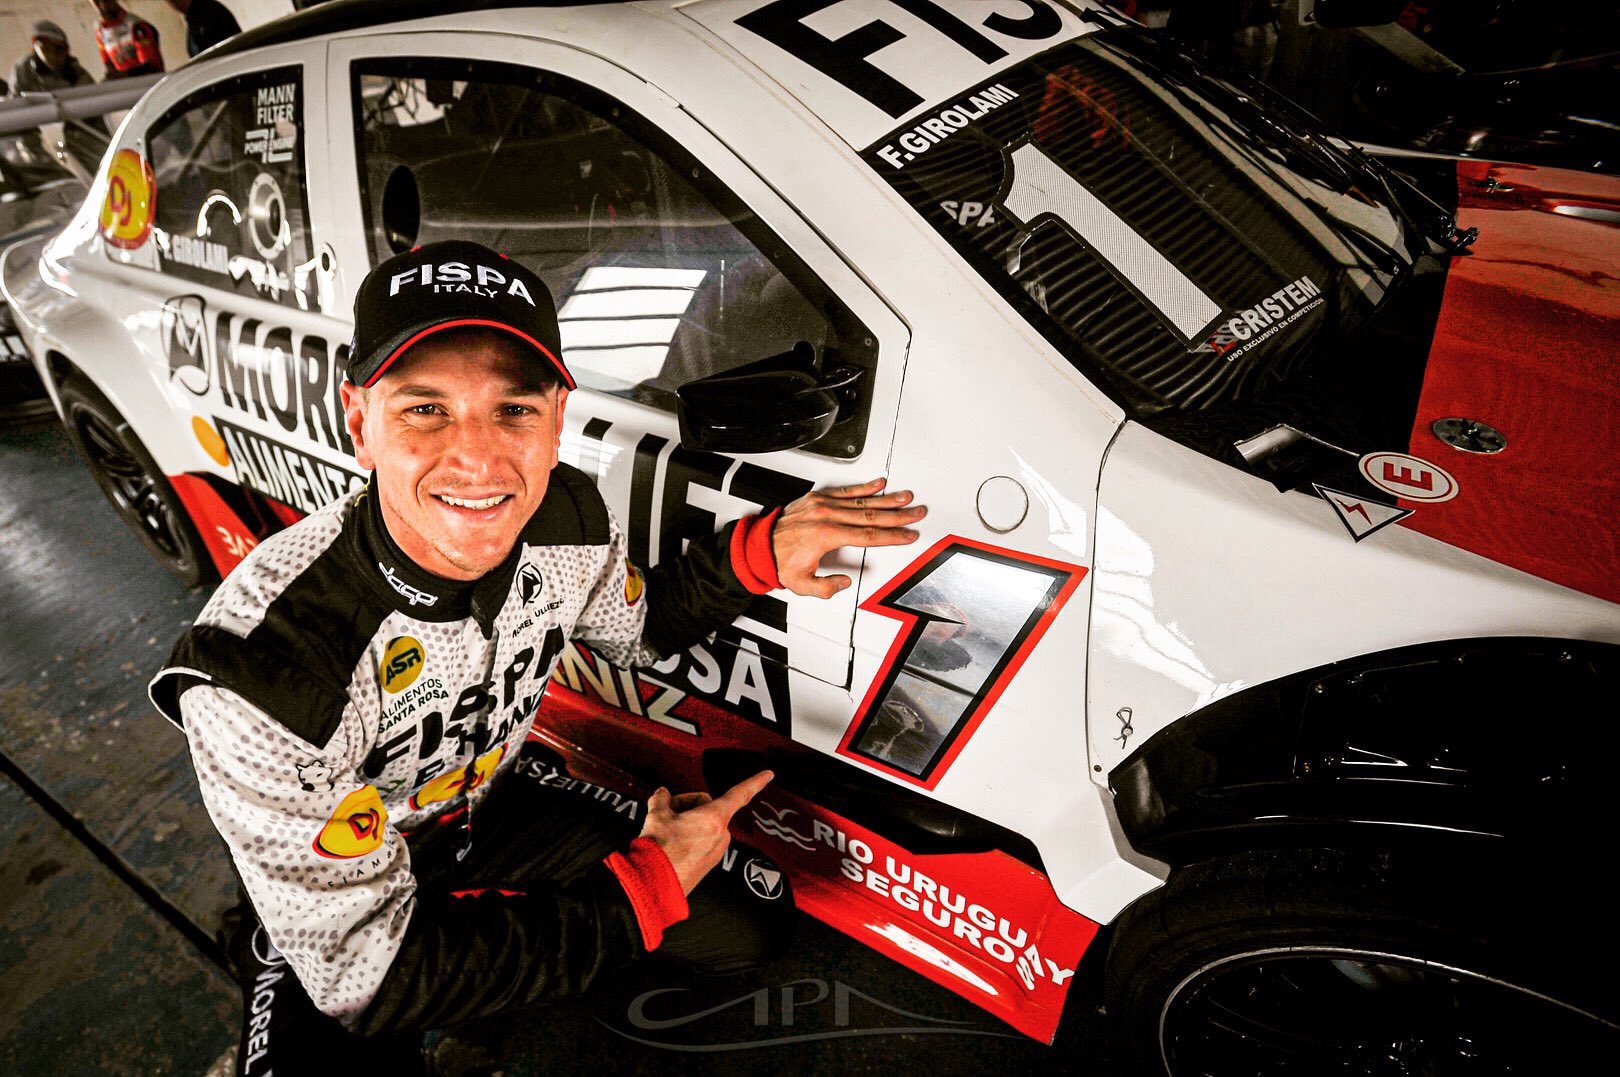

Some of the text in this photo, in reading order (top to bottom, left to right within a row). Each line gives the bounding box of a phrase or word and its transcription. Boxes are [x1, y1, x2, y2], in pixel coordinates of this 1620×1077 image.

[257, 83, 296, 107] MANN
[257, 104, 294, 125] FILTER
[876, 84, 1020, 170] F.GIROLAMI
[1001, 140, 1224, 342] 1
[389, 261, 536, 308] FISPA
[433, 283, 498, 299] ITALY
[1228, 275, 1322, 341] CRISTEM
[1227, 349, 1244, 362] USO
[1243, 326, 1279, 352] EXCLUSIVO
[1278, 320, 1289, 329] EN
[384, 647, 422, 686] ASR
[553, 640, 698, 736] NIZ
[652, 638, 778, 723] SA
[847, 541, 1074, 783] 1
[378, 688, 449, 734] SANTA ROSA
[381, 678, 443, 721] ALIMENTOS
[813, 819, 1074, 986] RIO URUGUAY
[841, 857, 1035, 991] SEGUROS
[244, 964, 285, 1075] MOREL
